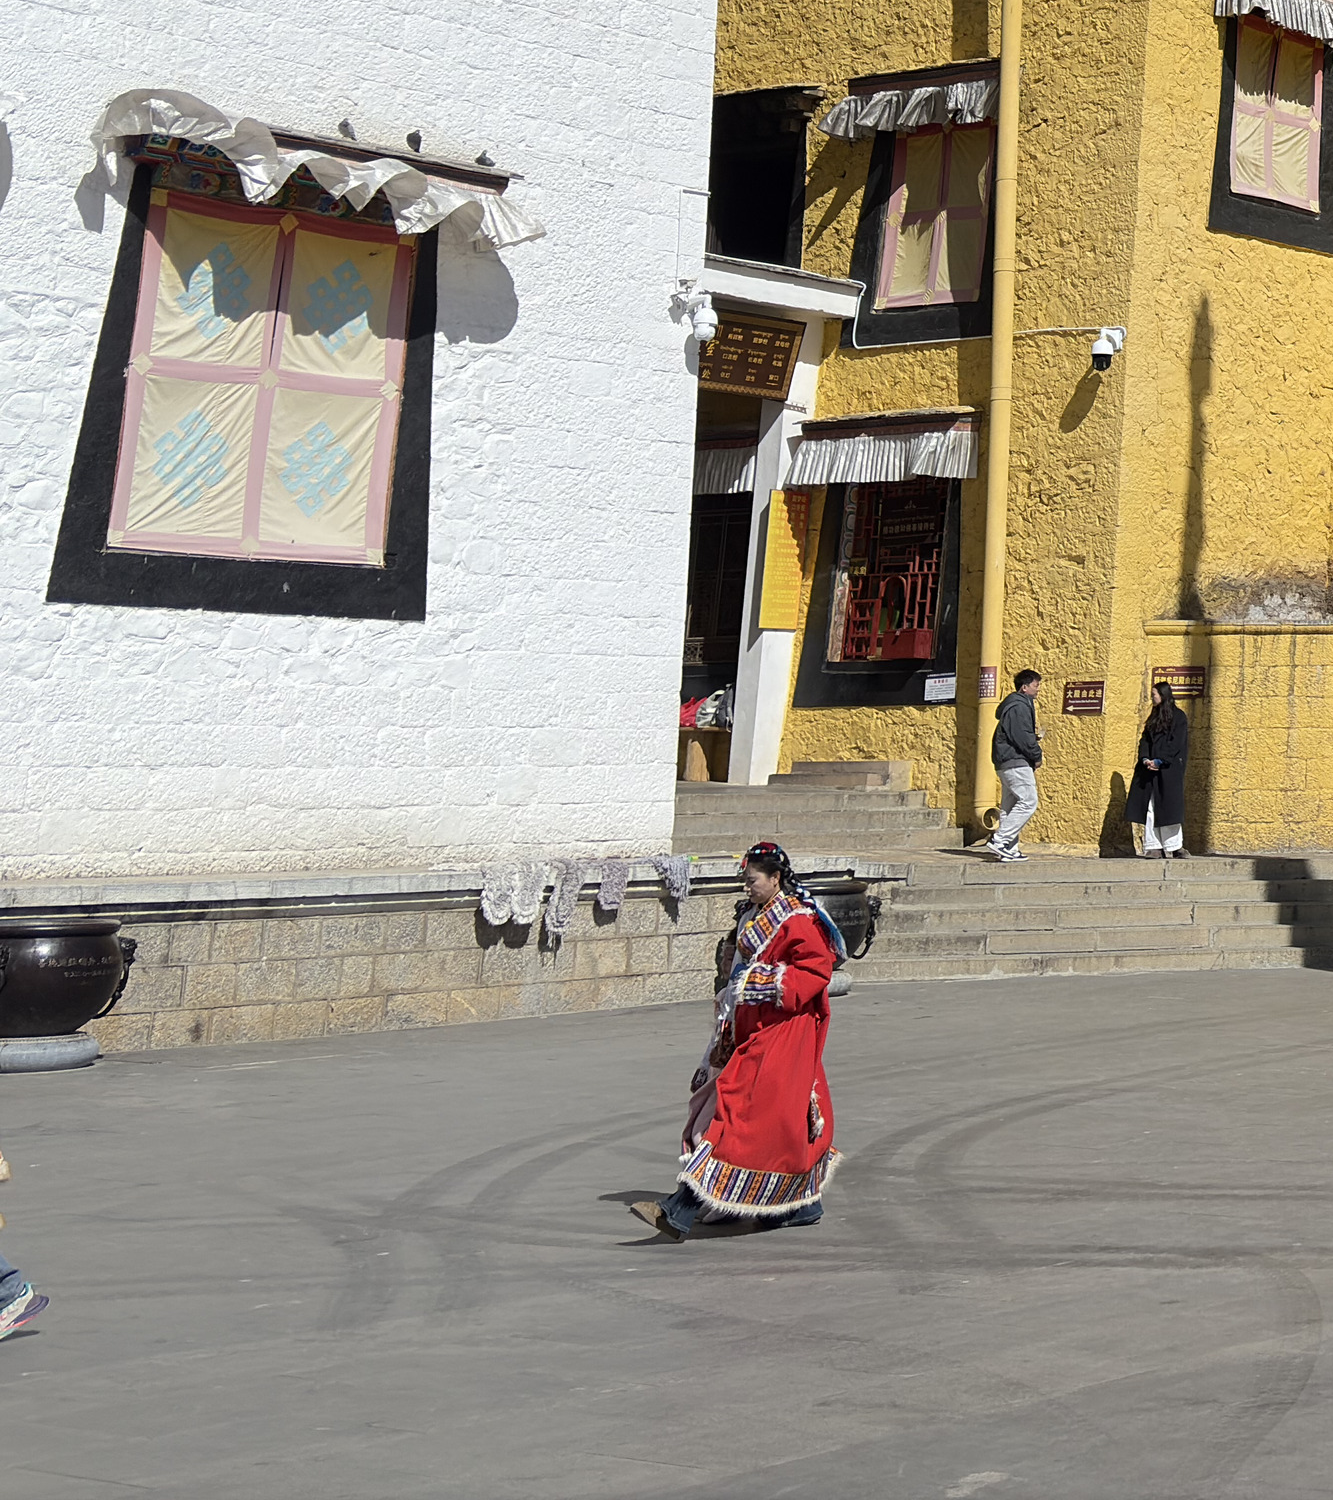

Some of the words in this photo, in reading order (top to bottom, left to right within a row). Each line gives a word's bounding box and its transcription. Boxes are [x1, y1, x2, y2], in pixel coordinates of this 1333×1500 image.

[1066, 689, 1102, 699] 大殿由此进
